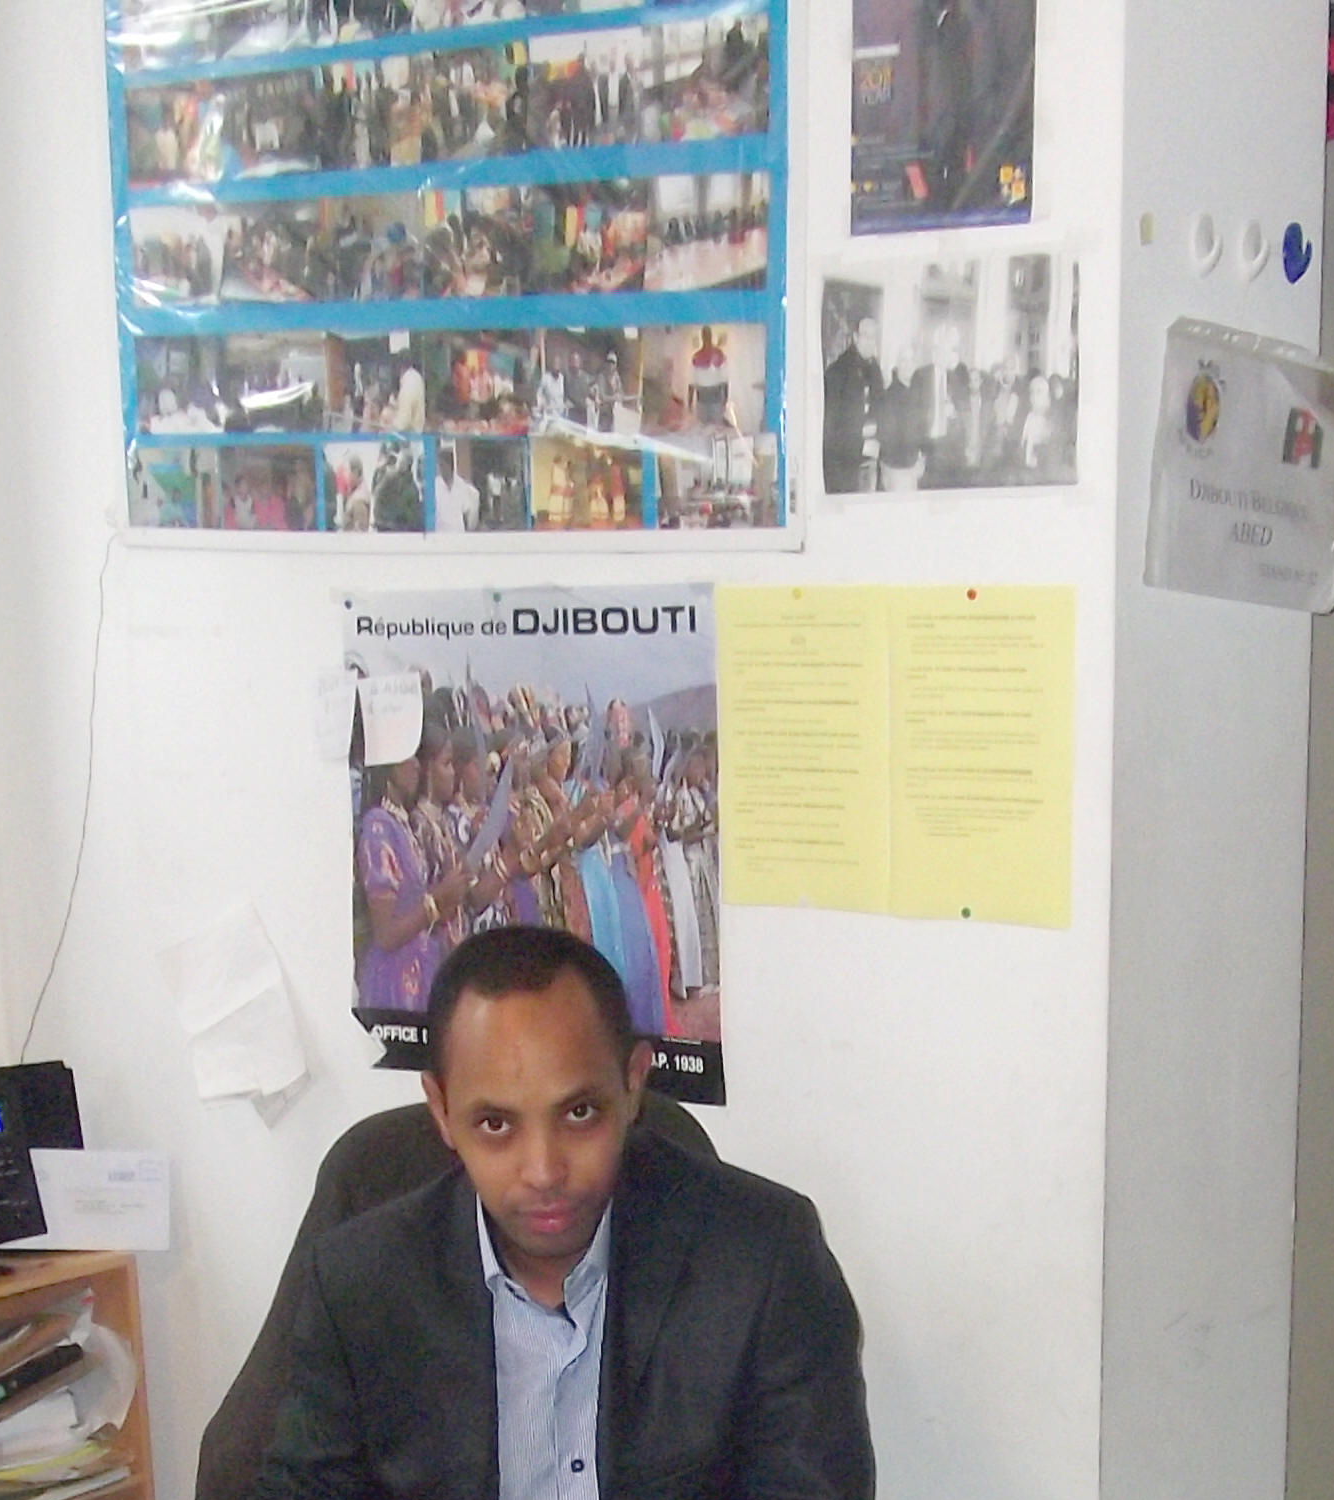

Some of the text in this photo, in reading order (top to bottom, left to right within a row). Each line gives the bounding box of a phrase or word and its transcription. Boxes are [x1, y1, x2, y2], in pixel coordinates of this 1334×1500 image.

[1230, 521, 1274, 547] ABED
[356, 605, 697, 640] République de DJIBOUTI
[371, 1024, 418, 1043] OFFICE
